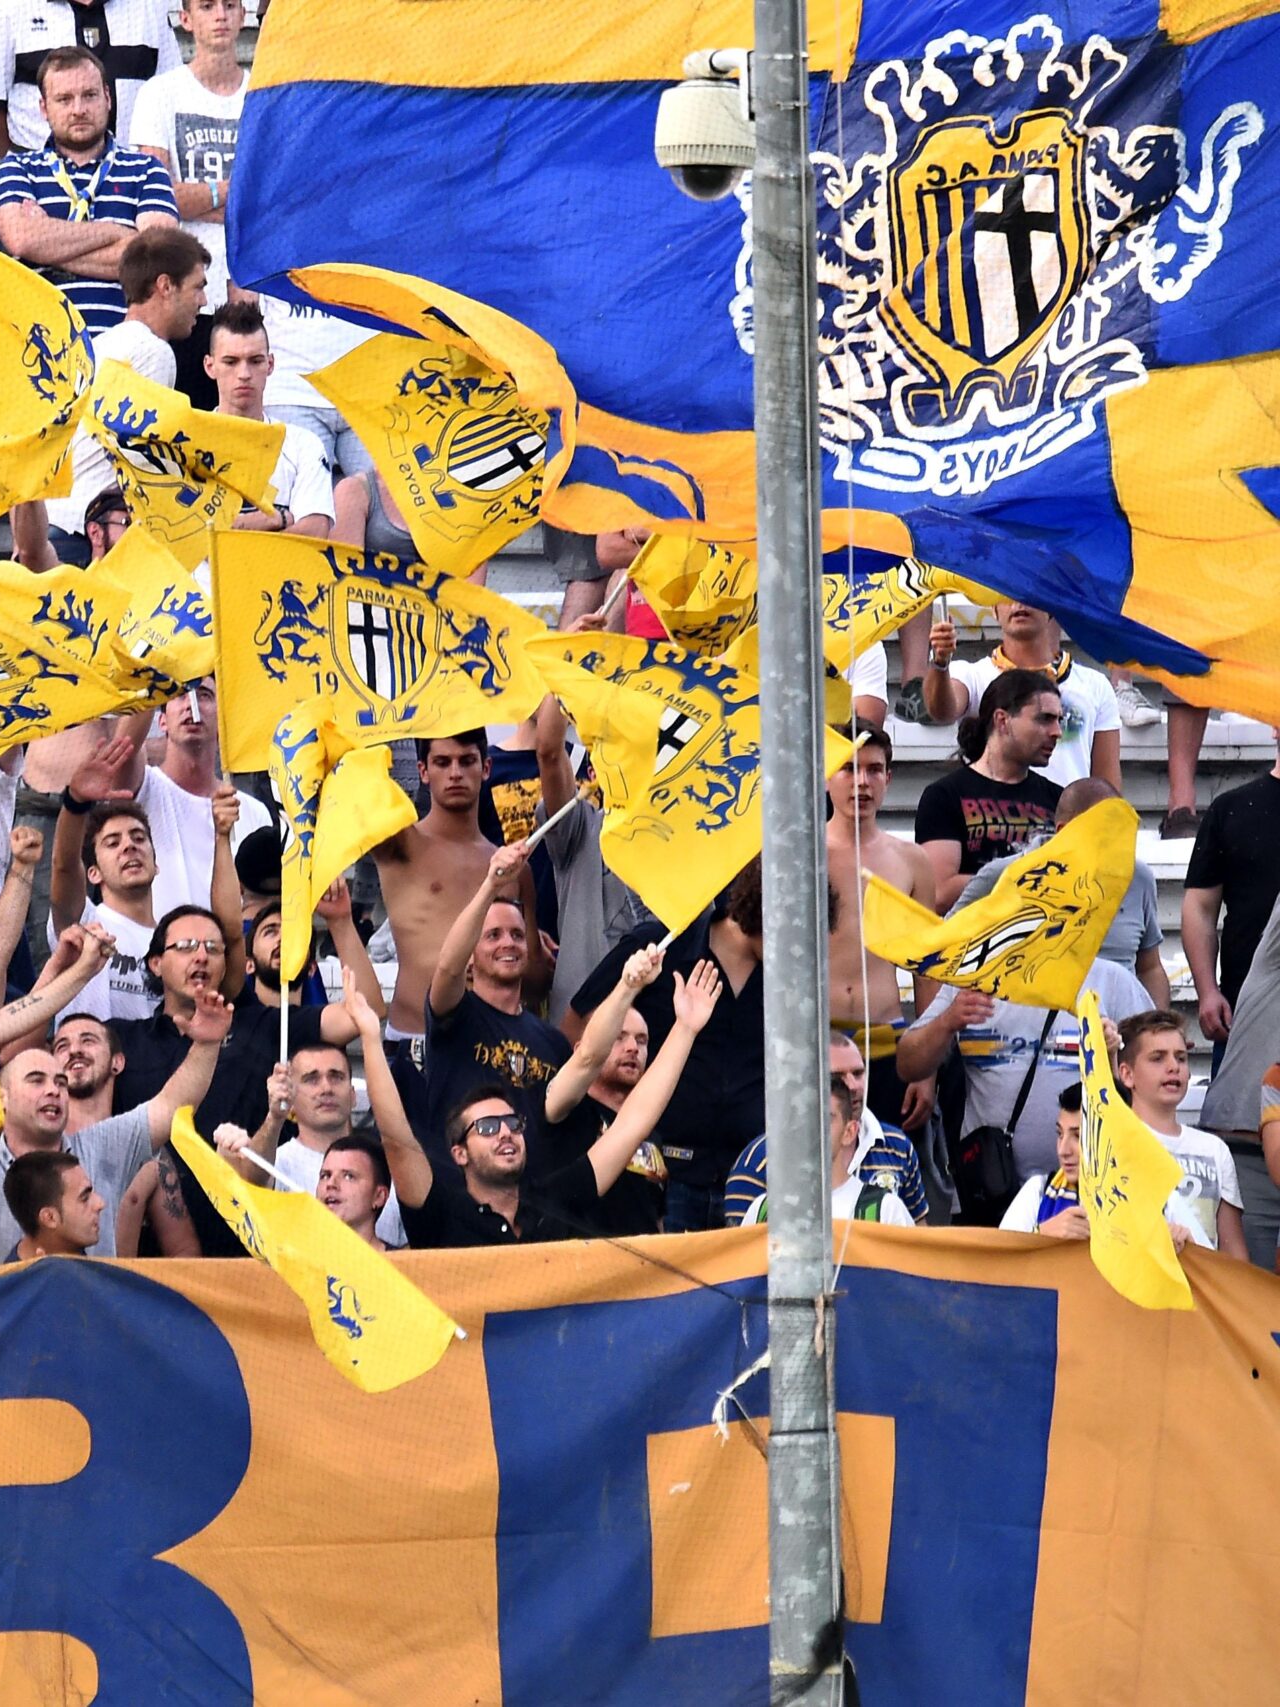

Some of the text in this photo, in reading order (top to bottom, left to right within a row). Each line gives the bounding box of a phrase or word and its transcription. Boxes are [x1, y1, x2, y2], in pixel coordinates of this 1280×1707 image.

[347, 587, 395, 606] PARMA
[312, 671, 339, 695] 19
[961, 798, 1045, 826] BACK
[1004, 954, 1025, 977] 19
